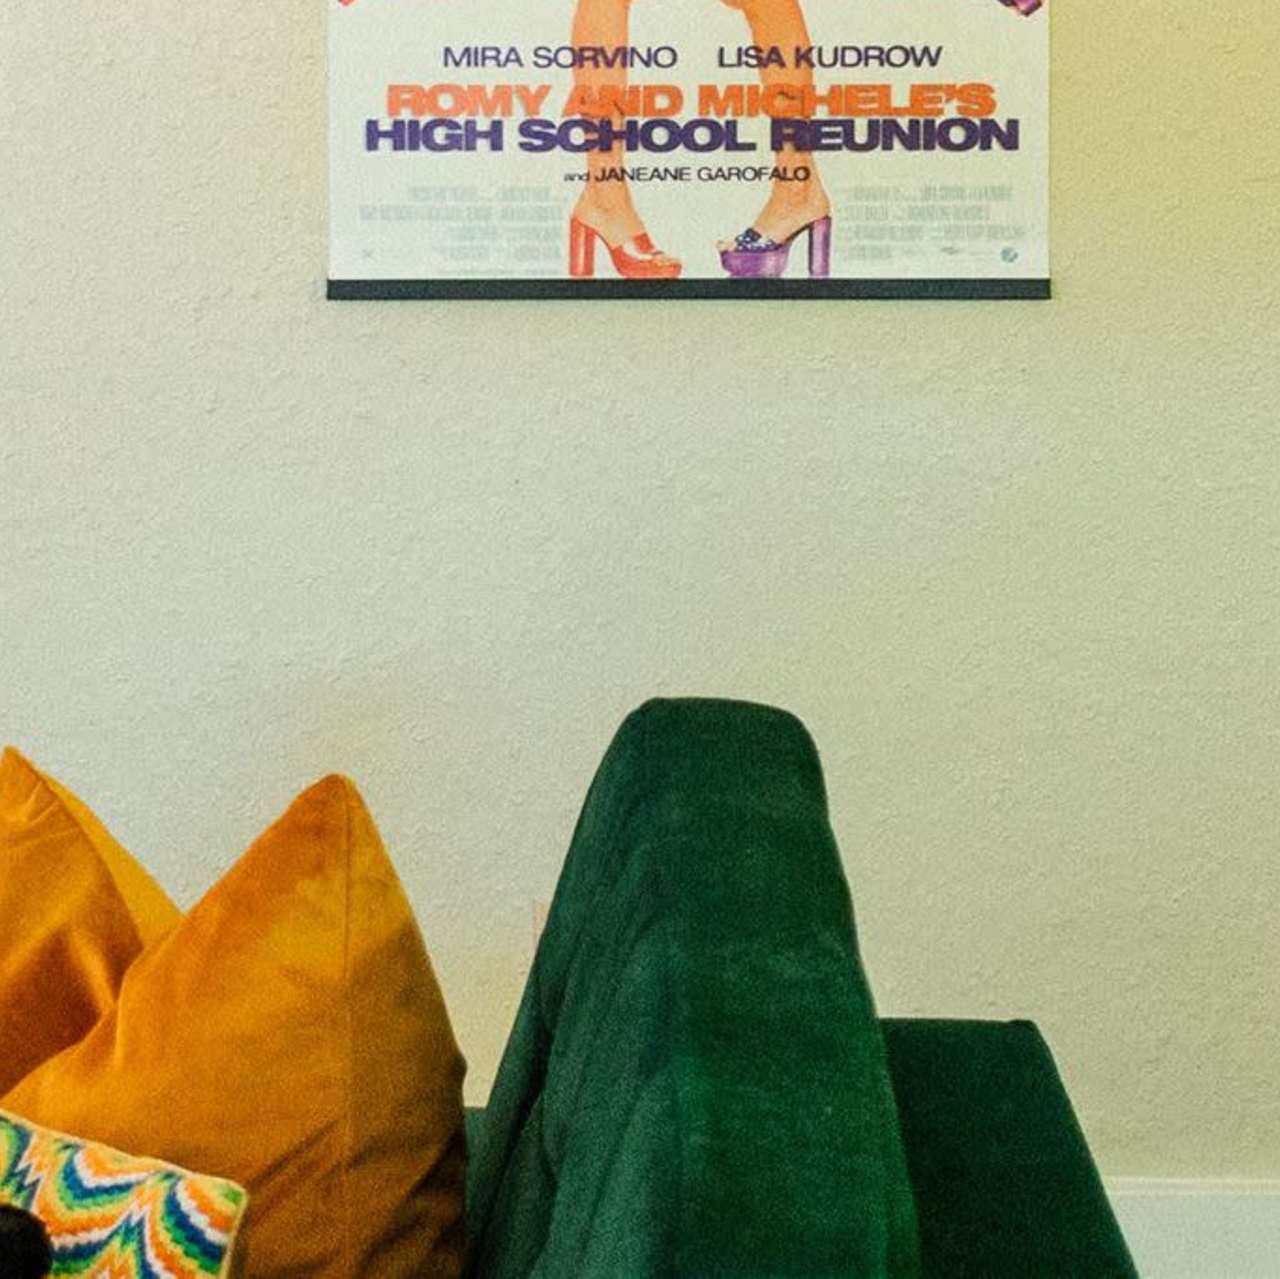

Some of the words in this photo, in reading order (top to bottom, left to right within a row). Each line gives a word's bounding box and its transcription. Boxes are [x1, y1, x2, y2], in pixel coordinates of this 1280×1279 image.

[443, 46, 524, 69] MIRA
[532, 46, 677, 68] SORVINO
[718, 46, 787, 68] LISA
[795, 45, 943, 67] KUDROW
[386, 84, 552, 117] ROMY
[562, 84, 684, 117] AND
[697, 83, 998, 117] MICHELE'S
[365, 119, 504, 151] HIGH
[517, 118, 757, 152] SCHOOL
[770, 118, 1020, 151] REUNION
[564, 172, 590, 181] and
[594, 167, 691, 181] JANEANE
[697, 166, 811, 181] GAROFALO
